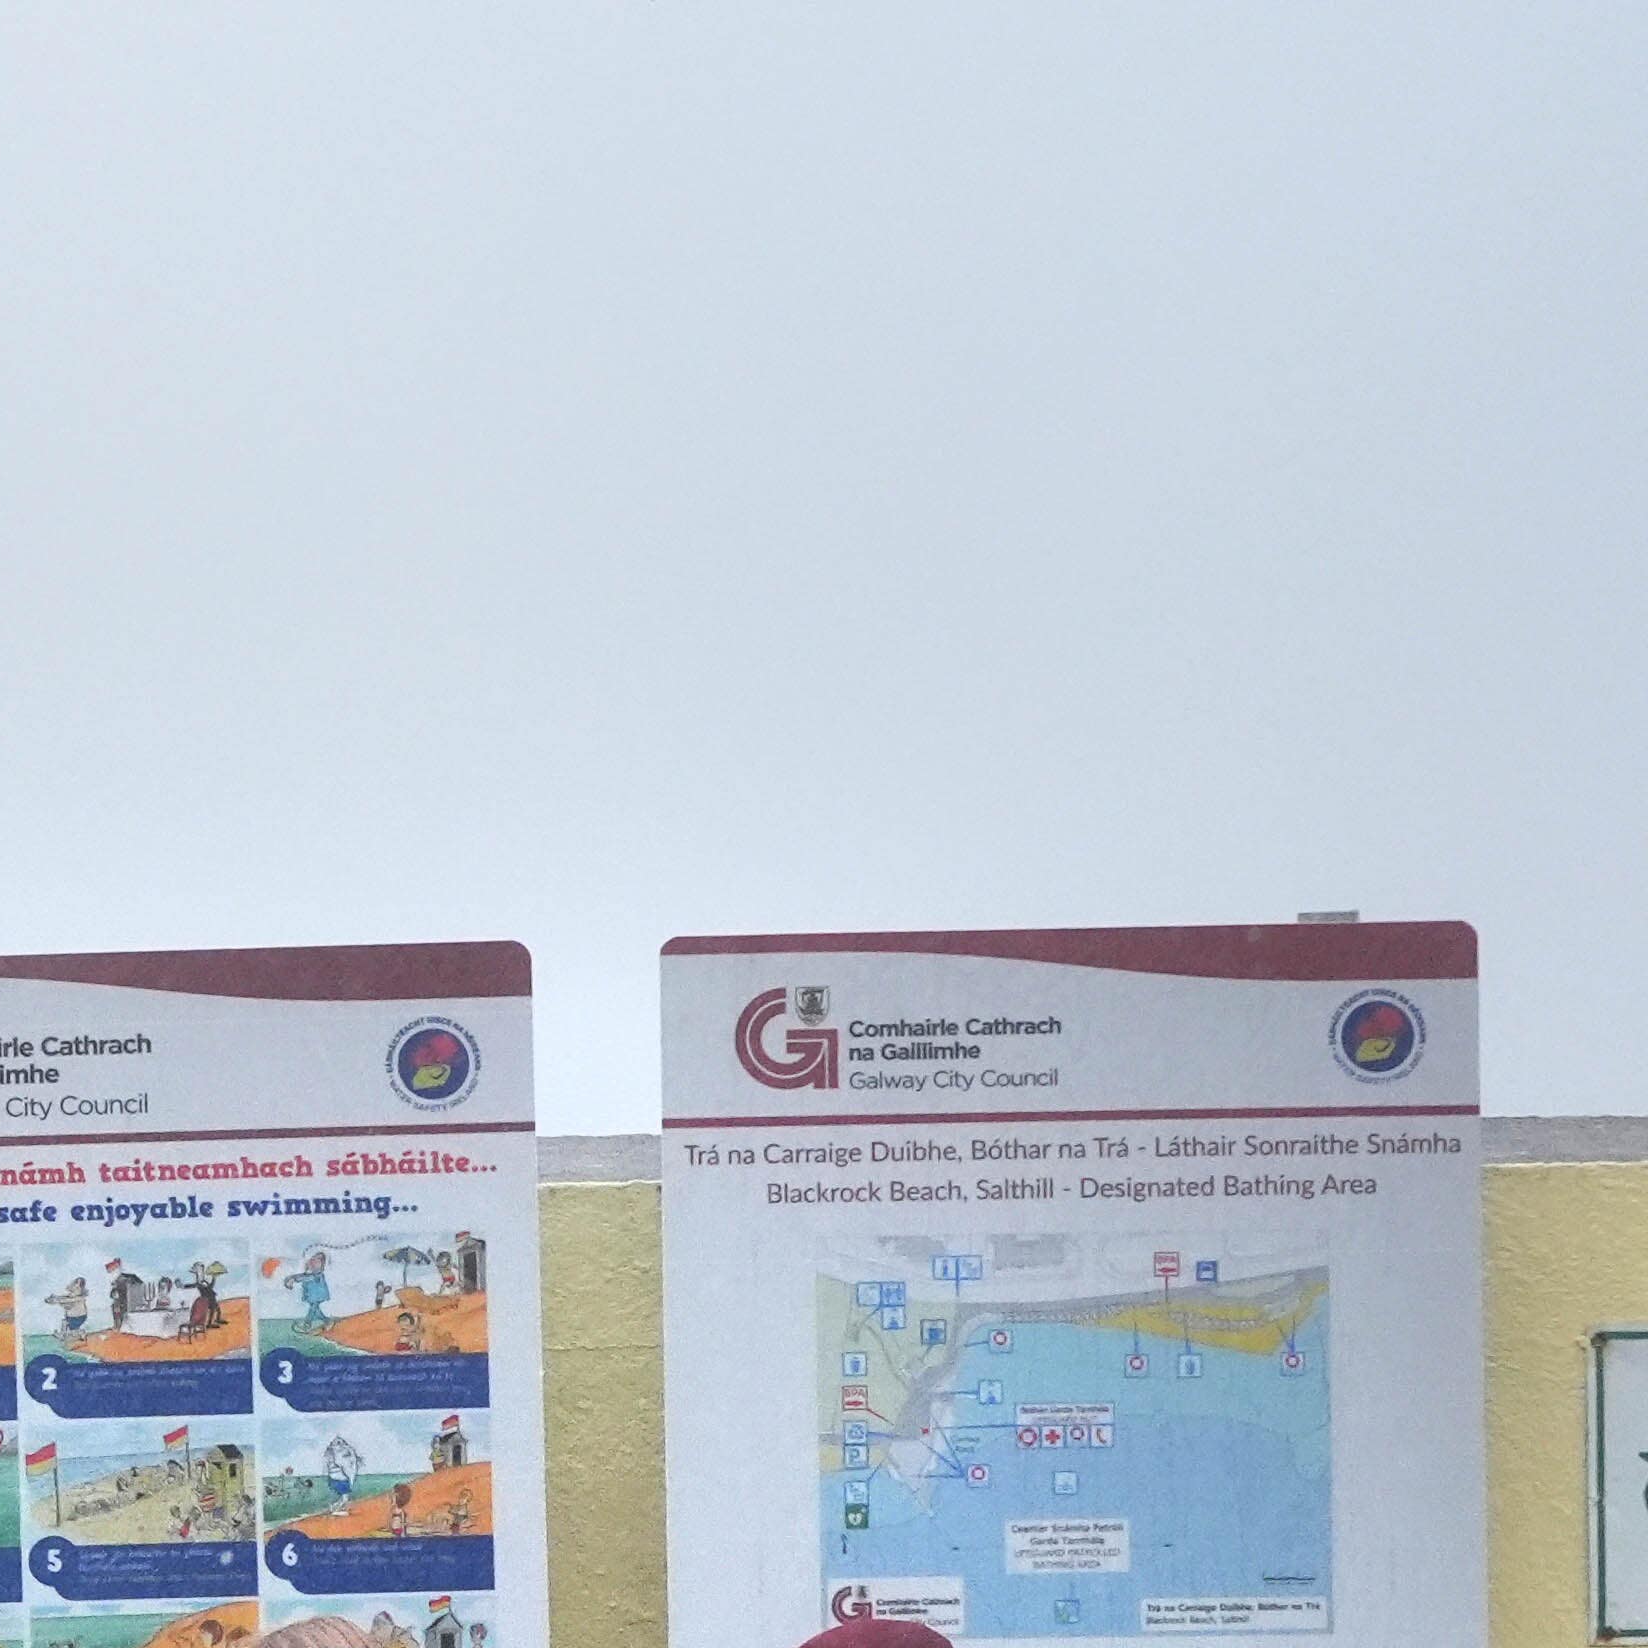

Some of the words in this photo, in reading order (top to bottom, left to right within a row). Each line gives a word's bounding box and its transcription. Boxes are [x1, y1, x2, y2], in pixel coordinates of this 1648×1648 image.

[849, 1019, 959, 1037] Comhairle
[966, 1017, 1061, 1035] Cathrach
[41, 1034, 151, 1056] Cathrach
[849, 1048, 874, 1061] na
[881, 1042, 981, 1060] Gaillimhe
[849, 1071, 927, 1092] Galway
[933, 1070, 975, 1091] City
[980, 1069, 1058, 1087] Council
[5, 1097, 53, 1120] City
[60, 1094, 148, 1116] Council
[684, 1145, 719, 1165] Trá
[728, 1150, 755, 1164] na
[764, 1144, 861, 1167] Carraige
[972, 1139, 1051, 1160] Bóthar
[1058, 1143, 1086, 1158] na
[1093, 1137, 1129, 1158] Trá
[1156, 1136, 1236, 1157] Láthair
[1244, 1134, 1359, 1156] Sonraithe
[1367, 1133, 1461, 1154] Snámha
[99, 1156, 313, 1182] taitneamhach
[768, 1183, 881, 1203] Blackrock
[890, 1181, 967, 1201] Beach,
[977, 1179, 1053, 1200] Salthill
[1080, 1176, 1215, 1202] Designated
[1224, 1175, 1315, 1199] Bathing
[1321, 1175, 1377, 1195] Area
[70, 1196, 213, 1227] enjoyable
[42, 1368, 57, 1390] 2
[278, 1361, 293, 1383] 3
[47, 1549, 62, 1572] 5
[282, 1543, 298, 1566] 6
